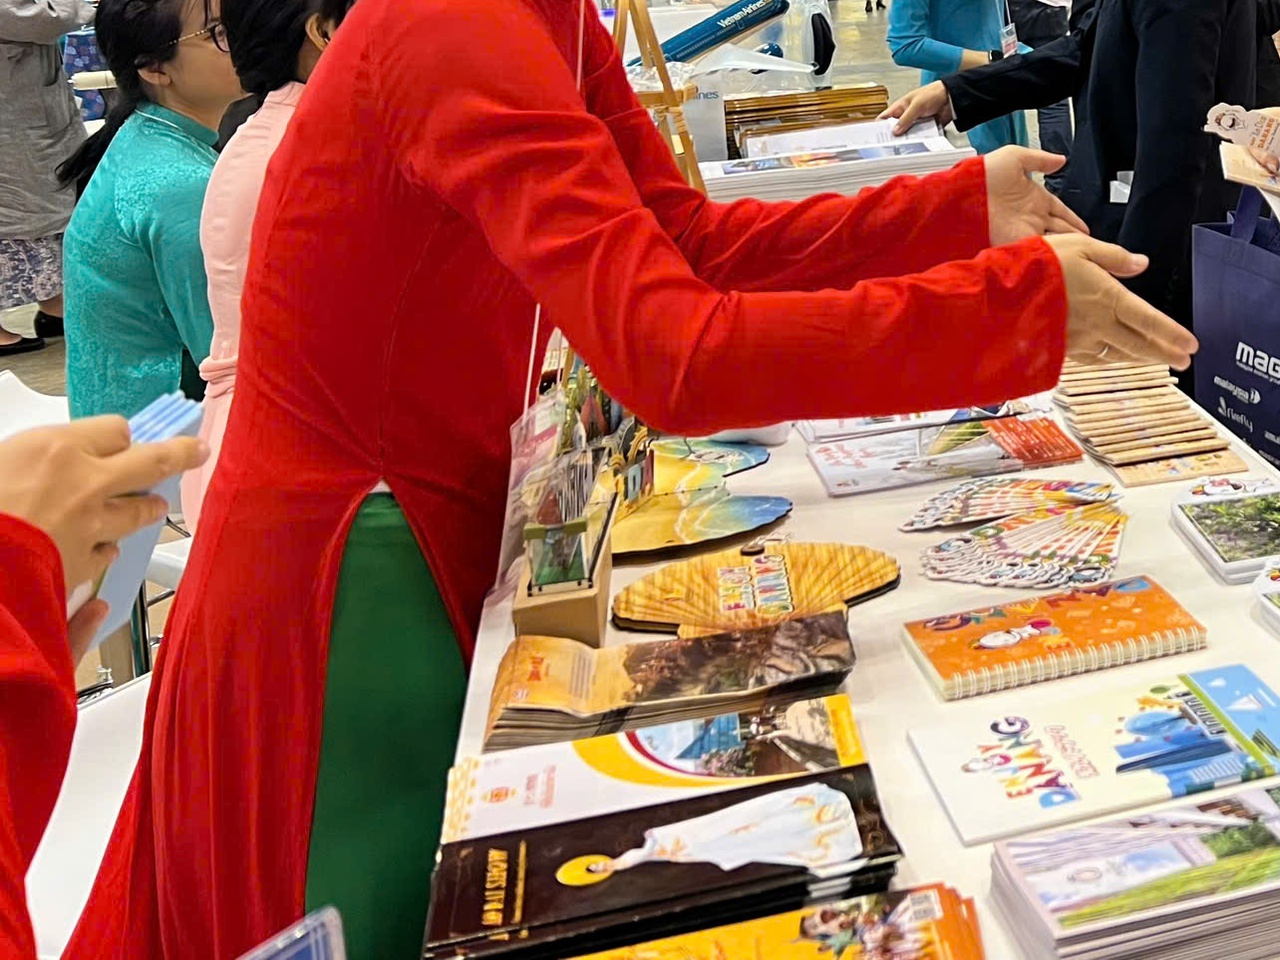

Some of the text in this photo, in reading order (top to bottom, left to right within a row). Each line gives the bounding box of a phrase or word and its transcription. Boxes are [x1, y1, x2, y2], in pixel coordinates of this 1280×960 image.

[717, 0, 766, 28] Vietnam Airlines
[1227, 407, 1253, 433] firefly
